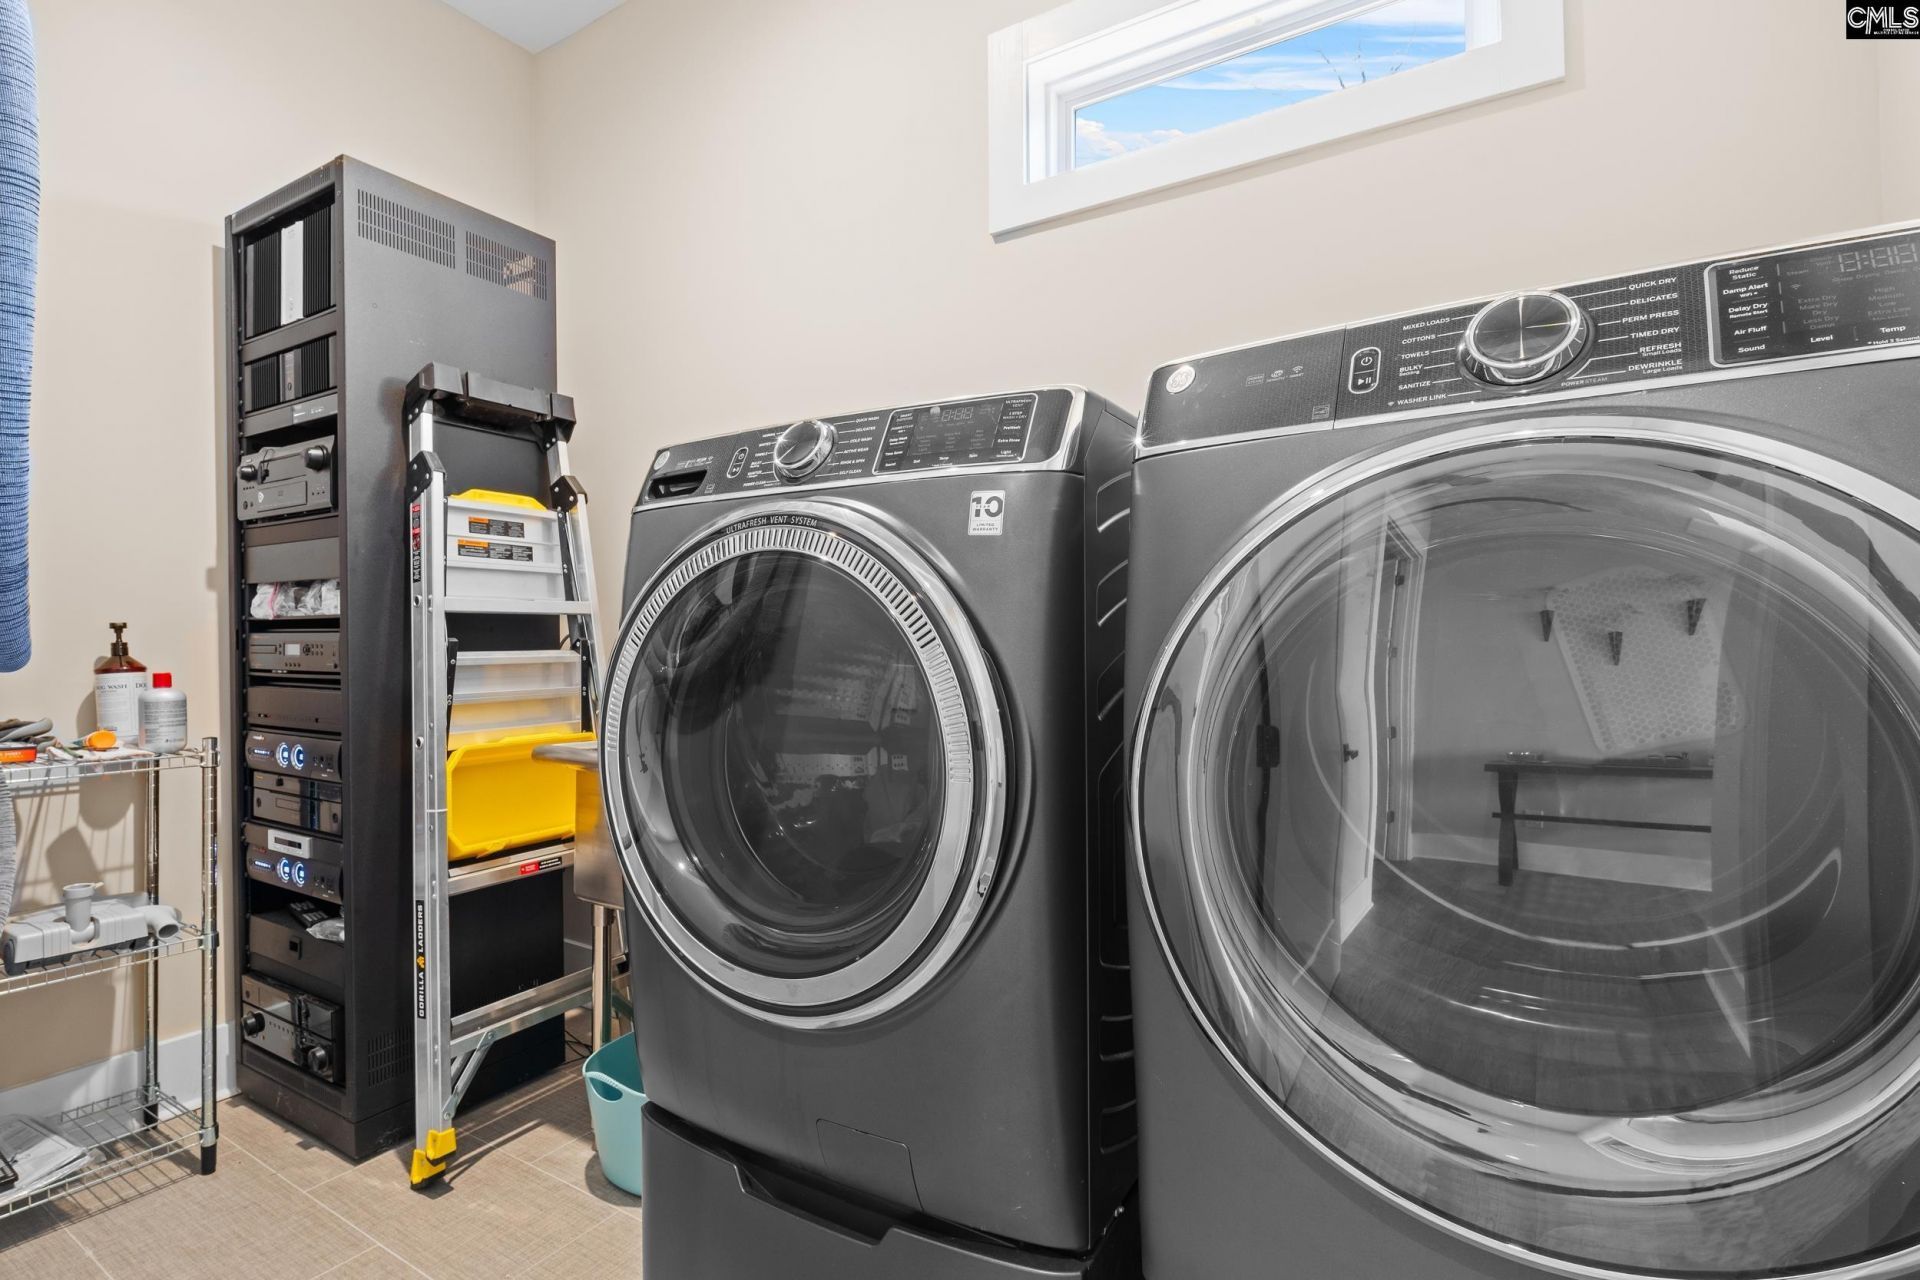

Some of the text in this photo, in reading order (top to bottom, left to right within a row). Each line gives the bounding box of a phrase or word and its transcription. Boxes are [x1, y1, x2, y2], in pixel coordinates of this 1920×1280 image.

[1729, 265, 1759, 275] Reduce
[1732, 272, 1757, 280] Static
[1628, 277, 1677, 290] QUICK DRY
[1722, 281, 1769, 296] Damp Alert
[1630, 293, 1678, 305] DELICATES
[1728, 302, 1768, 314] Delay Dry
[1622, 309, 1679, 323] PERM PRESS
[1402, 317, 1450, 331] MIXED LOADS
[1880, 325, 1906, 334] Temp
[1630, 326, 1680, 339] TIMED DRY
[1734, 325, 1767, 336] Air Fluff
[1401, 334, 1436, 345] COTTONS
[1810, 334, 1834, 343] Level
[1639, 342, 1682, 353] REFRESH
[1738, 344, 1766, 353] Sound
[1401, 350, 1430, 360] TOWELS
[1399, 364, 1423, 373] BULKY
[1628, 358, 1683, 371] DEWRINKLE
[1398, 380, 1431, 391] SANITIZE
[1397, 393, 1447, 405] WASHER LINK
[971, 495, 1003, 518] 10
[726, 515, 818, 534] ULTRAFRESH VENT SYSTEM
